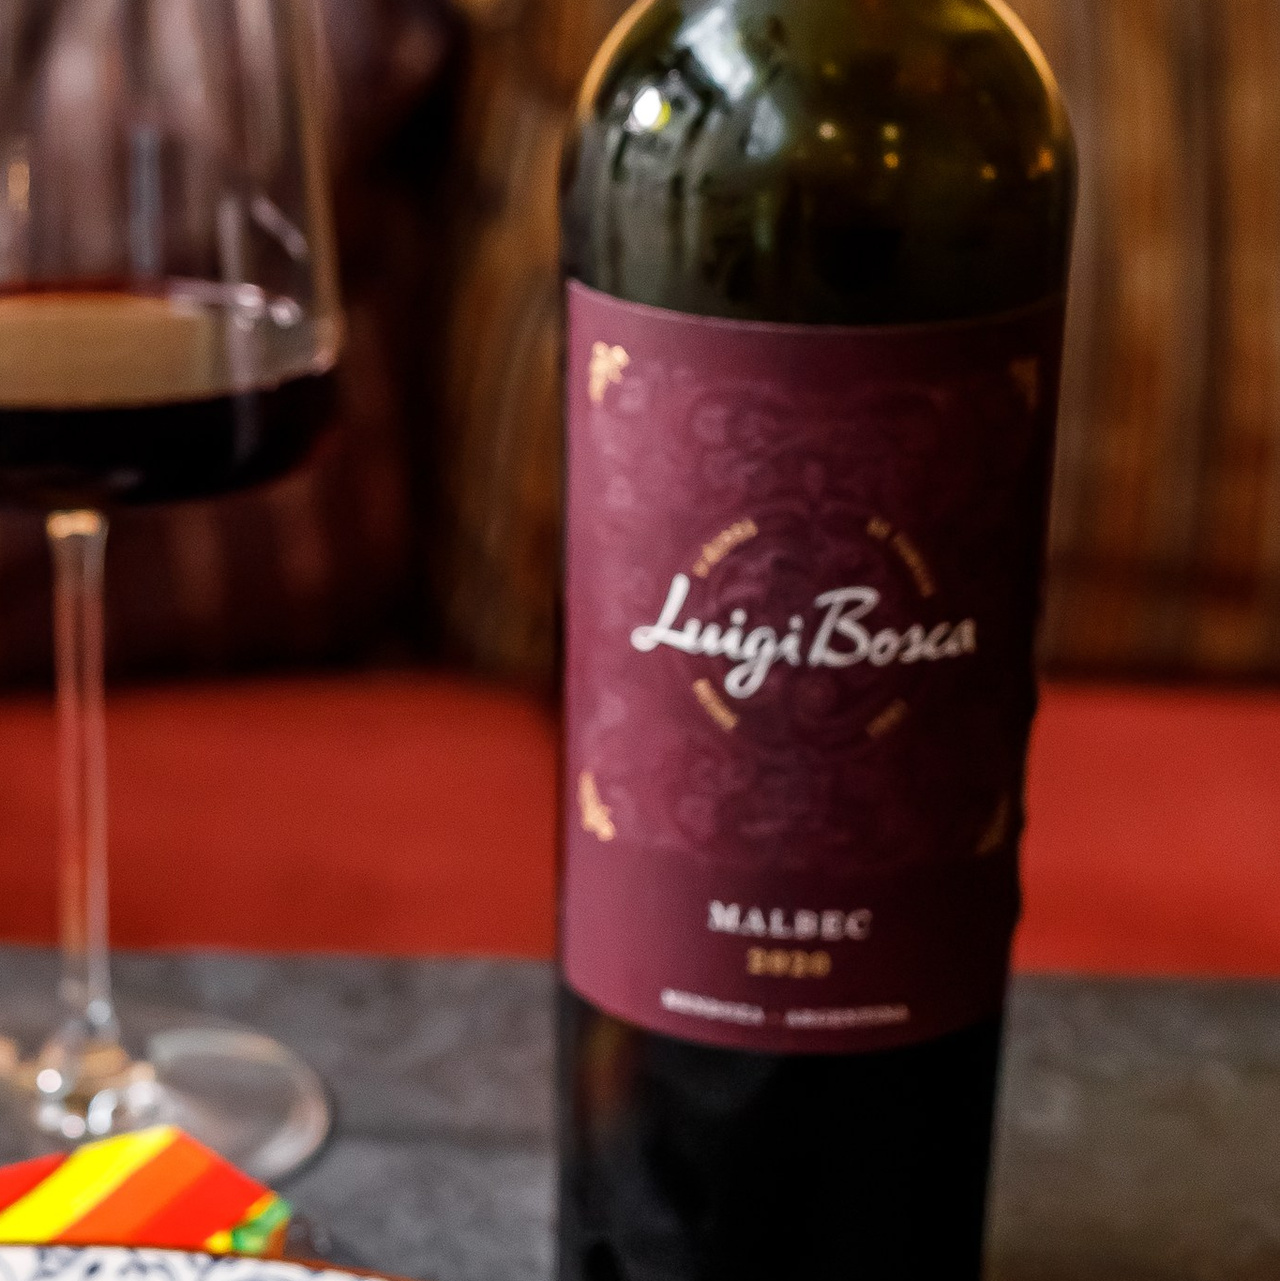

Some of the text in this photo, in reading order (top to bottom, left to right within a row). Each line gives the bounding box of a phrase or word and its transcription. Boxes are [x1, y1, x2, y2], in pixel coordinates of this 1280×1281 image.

[629, 573, 977, 699] Luigi Bosca
[707, 899, 873, 941] MALBEC
